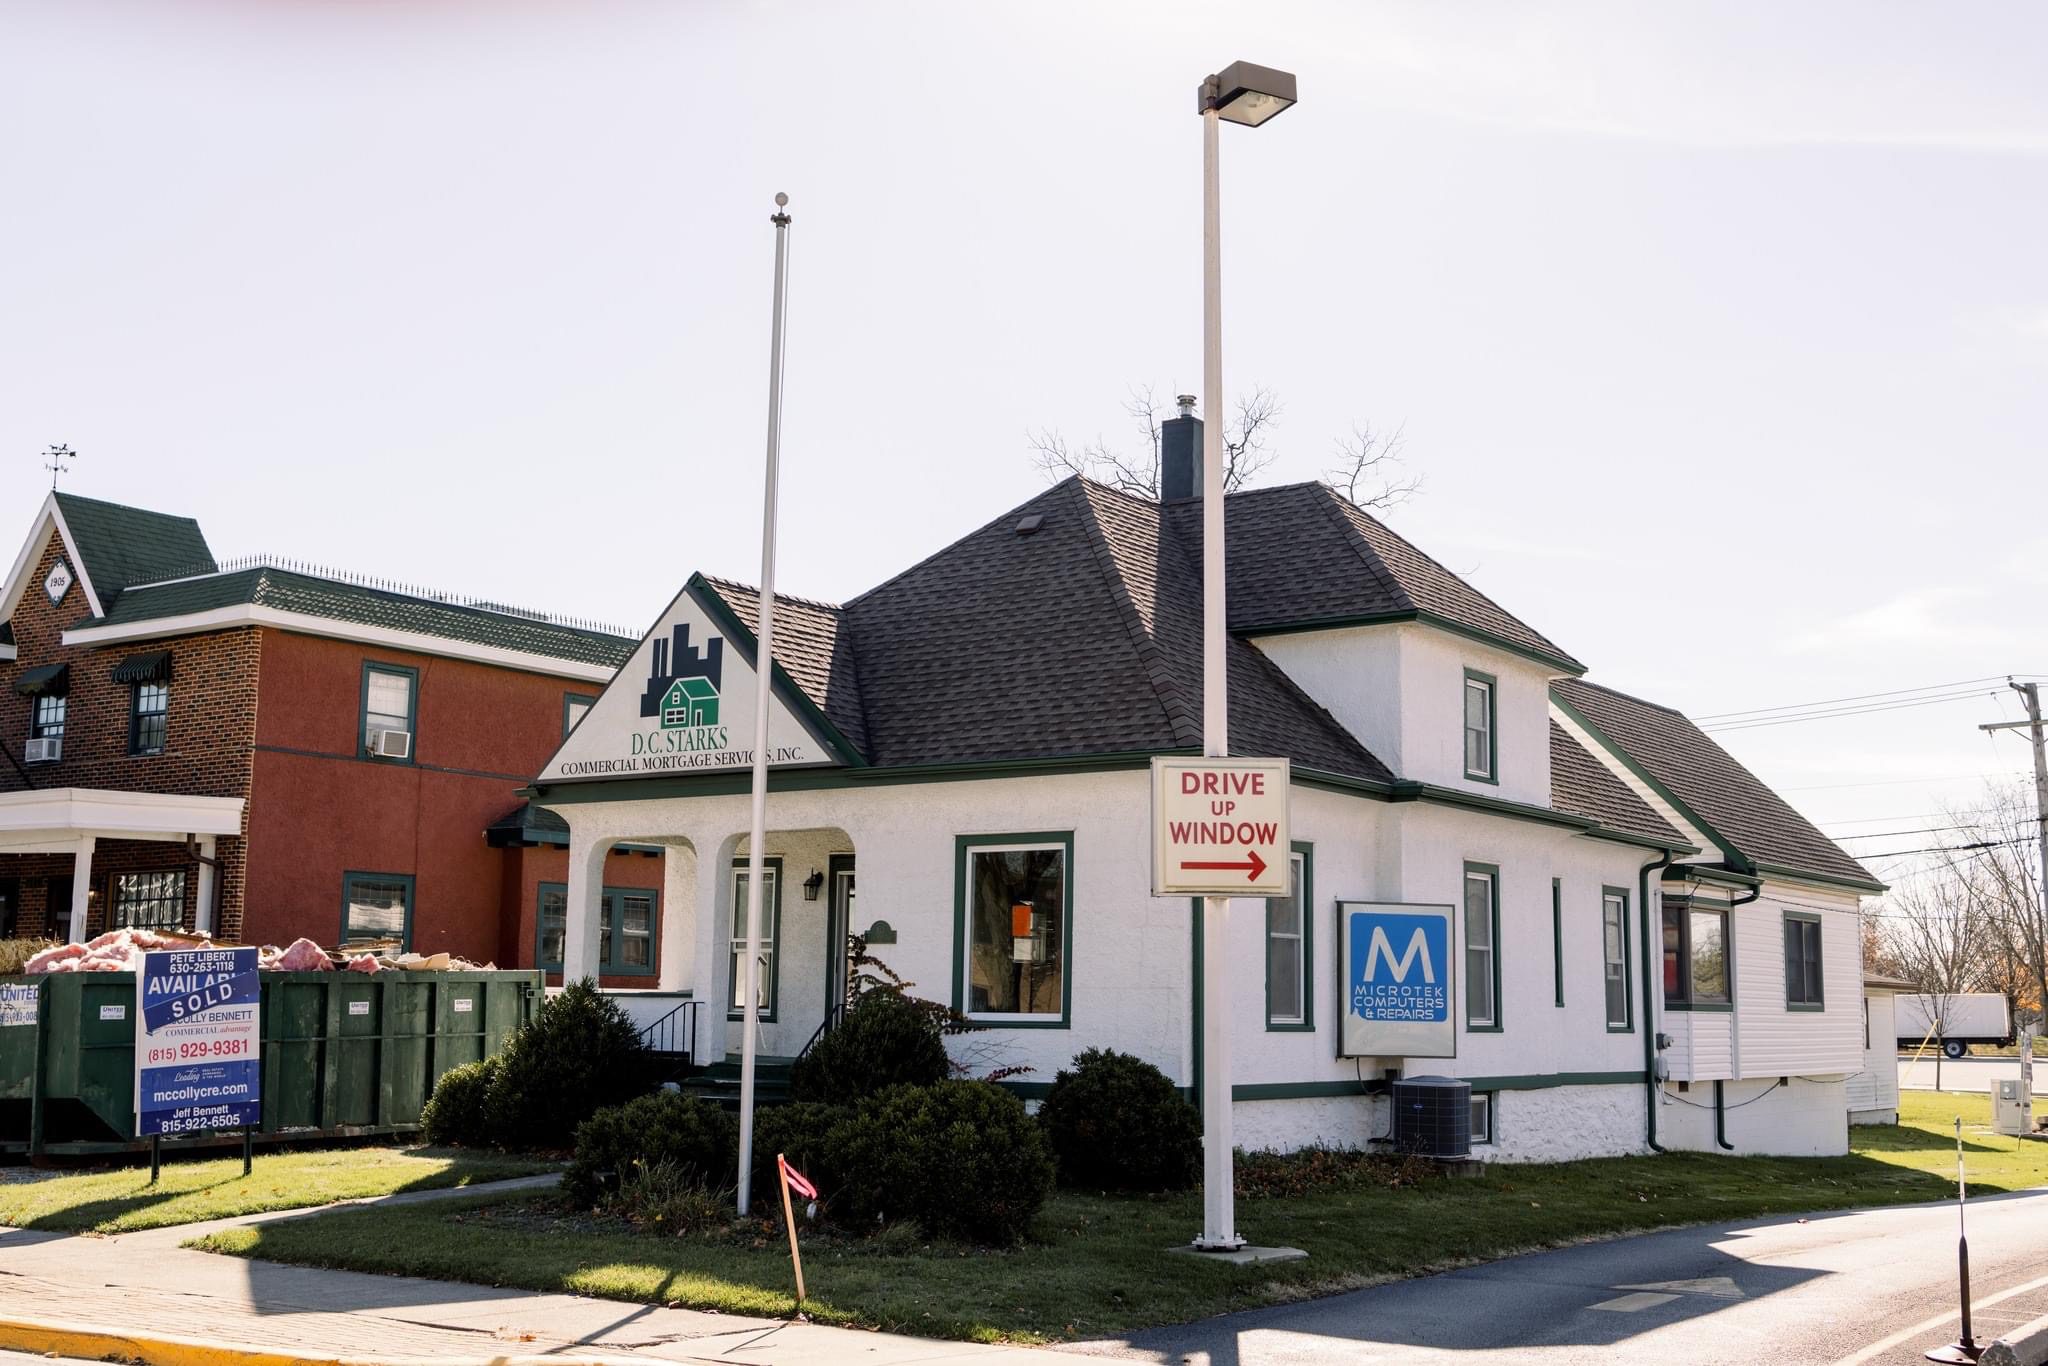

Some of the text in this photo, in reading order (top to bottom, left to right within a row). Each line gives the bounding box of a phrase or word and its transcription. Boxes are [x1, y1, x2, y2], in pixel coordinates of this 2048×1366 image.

[631, 726, 728, 755] D.C. STARKS
[560, 746, 804, 776] COMMERCIAL MORTGAGE SERVICS, INC.
[1181, 771, 1265, 796] DRIVE
[1211, 800, 1236, 817] UP
[1169, 821, 1278, 845] WINDOW
[170, 951, 235, 963] PETE LIBERTI
[169, 961, 234, 974] 630-263-1118
[1354, 985, 1443, 997] MICROTEK
[171, 982, 233, 1018] SOLD
[1353, 996, 1445, 1009] COMPUTERS
[208, 1010, 253, 1022] BENNETT
[1365, 1007, 1434, 1020] & REPAIRS
[165, 1025, 252, 1037] COMMERCIAL advantage
[148, 1039, 249, 1064] (815) 929-9381
[153, 1083, 248, 1102] mccollycre.com
[173, 1104, 229, 1119] Jeff Bennett
[161, 1113, 240, 1133] 815-922-6505
